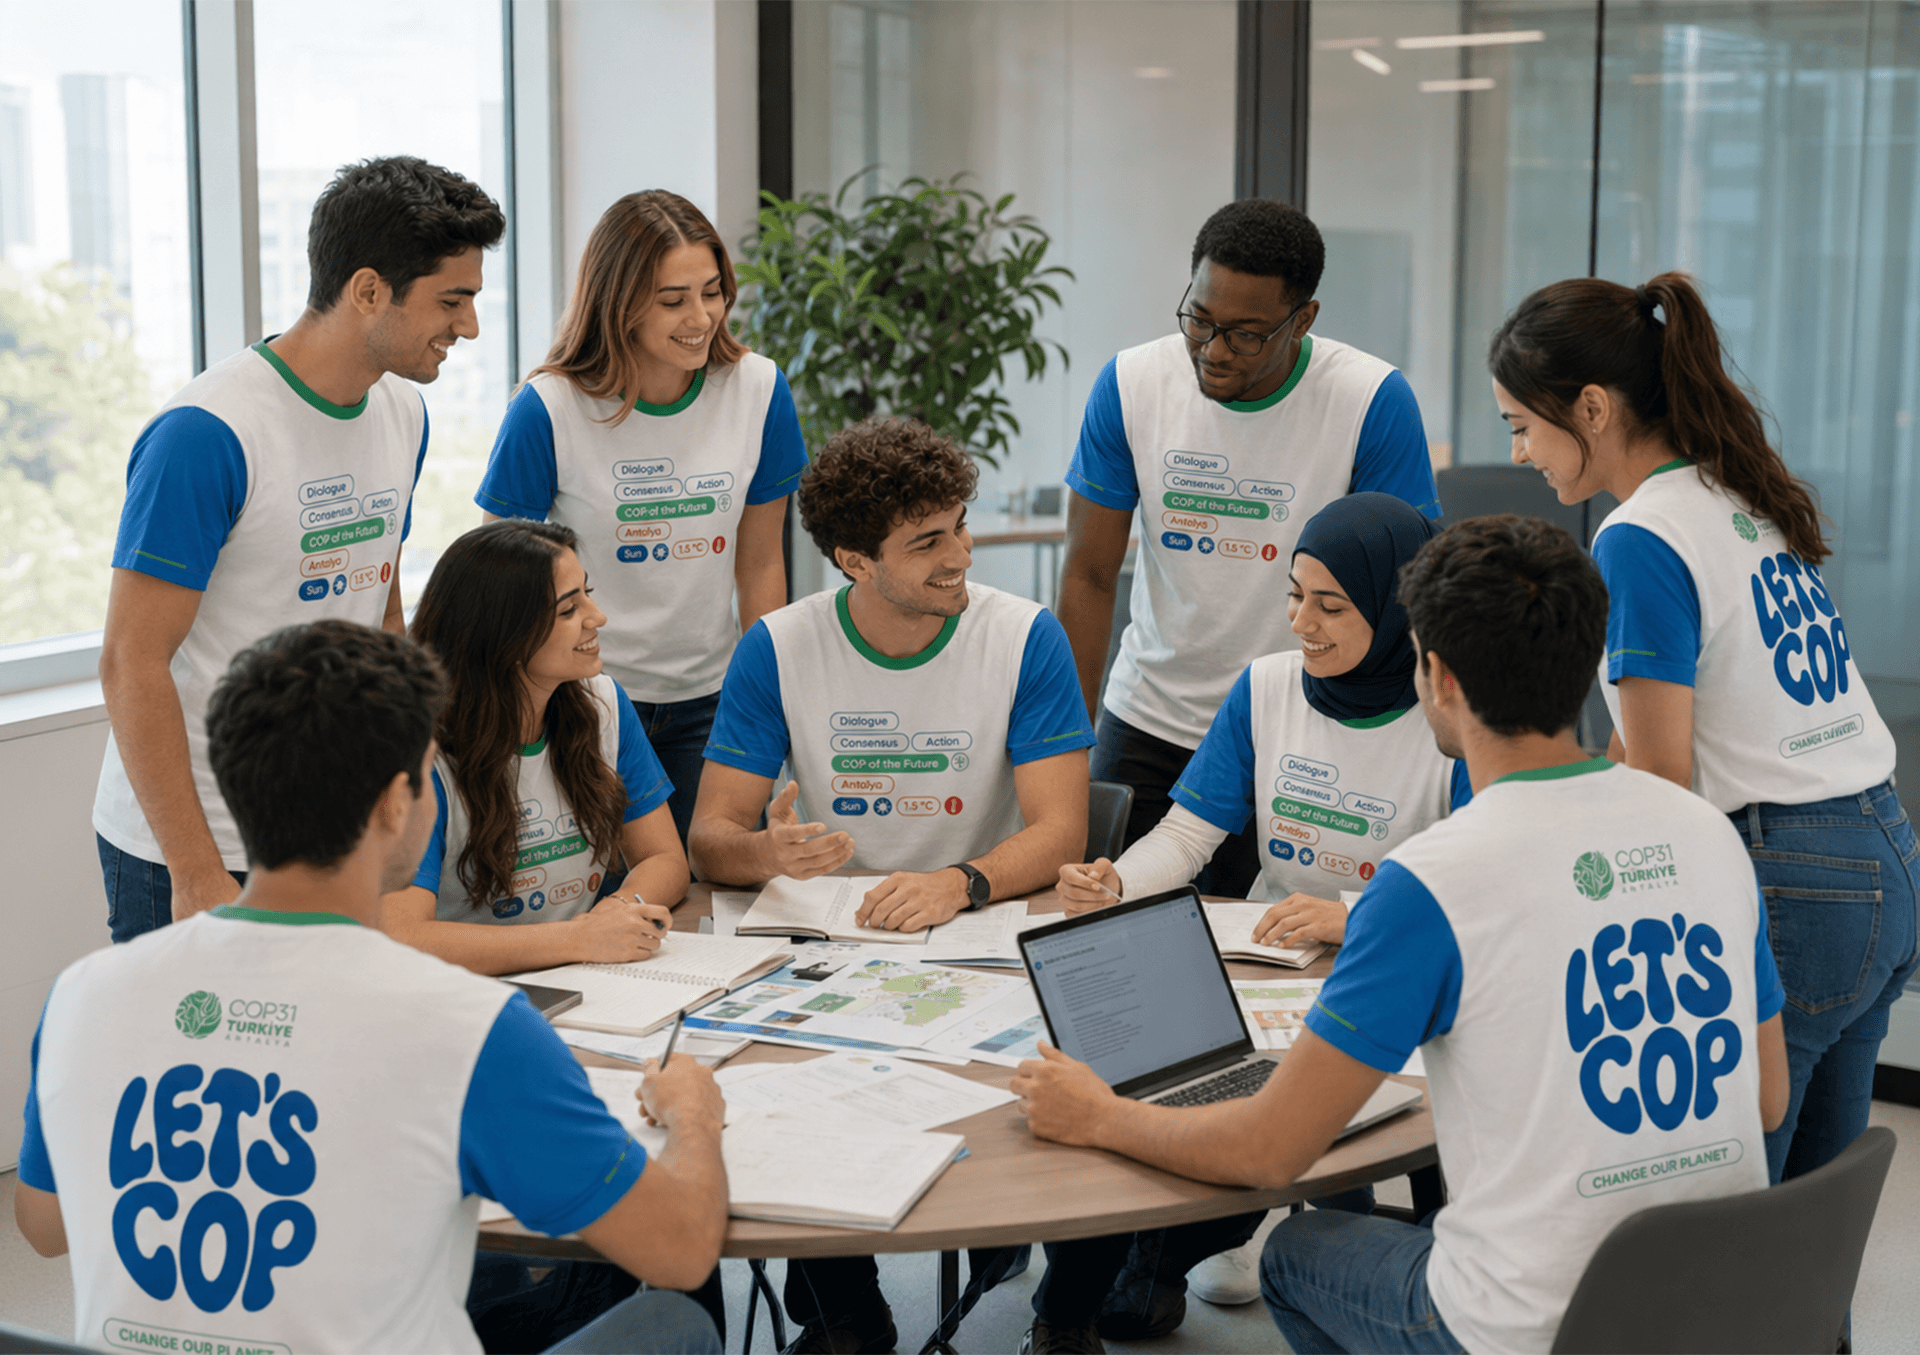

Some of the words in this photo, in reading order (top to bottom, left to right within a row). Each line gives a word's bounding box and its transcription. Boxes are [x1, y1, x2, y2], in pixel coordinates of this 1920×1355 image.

[1174, 455, 1218, 469] Dialogue
[622, 464, 664, 475] Dialogue
[307, 483, 346, 498] Dialogue
[623, 485, 674, 496] Consensus
[696, 480, 724, 490] Action
[1250, 485, 1282, 496] Action
[371, 497, 393, 510] Action
[624, 508, 647, 518] COP
[648, 506, 658, 516] of
[661, 505, 676, 514] the
[679, 502, 707, 512] Future
[1172, 496, 1194, 506] COP
[1196, 499, 1206, 509] of
[1208, 501, 1225, 511] the
[1228, 504, 1260, 514] Future
[624, 527, 662, 538] Antalya
[309, 534, 330, 548] COP
[1168, 536, 1186, 546] Sun
[624, 548, 642, 558] Sun
[306, 585, 324, 596] Sun
[1774, 617, 1850, 706] COP
[840, 716, 888, 728] Dialogue
[840, 738, 898, 748] Consensus
[926, 736, 960, 746] Action
[841, 759, 866, 769] COP
[868, 759, 880, 768] of
[882, 759, 900, 768] the
[904, 759, 938, 768] Future
[1288, 760, 1328, 778] Dialogue
[841, 780, 882, 791] Antalya
[841, 801, 860, 811] Sun
[904, 801, 918, 811] 1.5
[1279, 802, 1300, 814] COP
[1302, 808, 1312, 818] of
[1354, 800, 1384, 814] Action
[1274, 843, 1289, 856] Sun
[1615, 844, 1674, 868] COP31
[1566, 912, 1732, 1053] LET'S
[229, 999, 298, 1022] COP31
[1580, 1018, 1742, 1135] COP
[109, 1064, 318, 1196] LET'S
[1592, 1166, 1648, 1189] CHANGE
[1651, 1160, 1677, 1176] OUR
[1680, 1147, 1728, 1168] PLANET
[112, 1181, 317, 1313] COP
[118, 1328, 178, 1350] CHANGE
[182, 1340, 213, 1355] OUR
